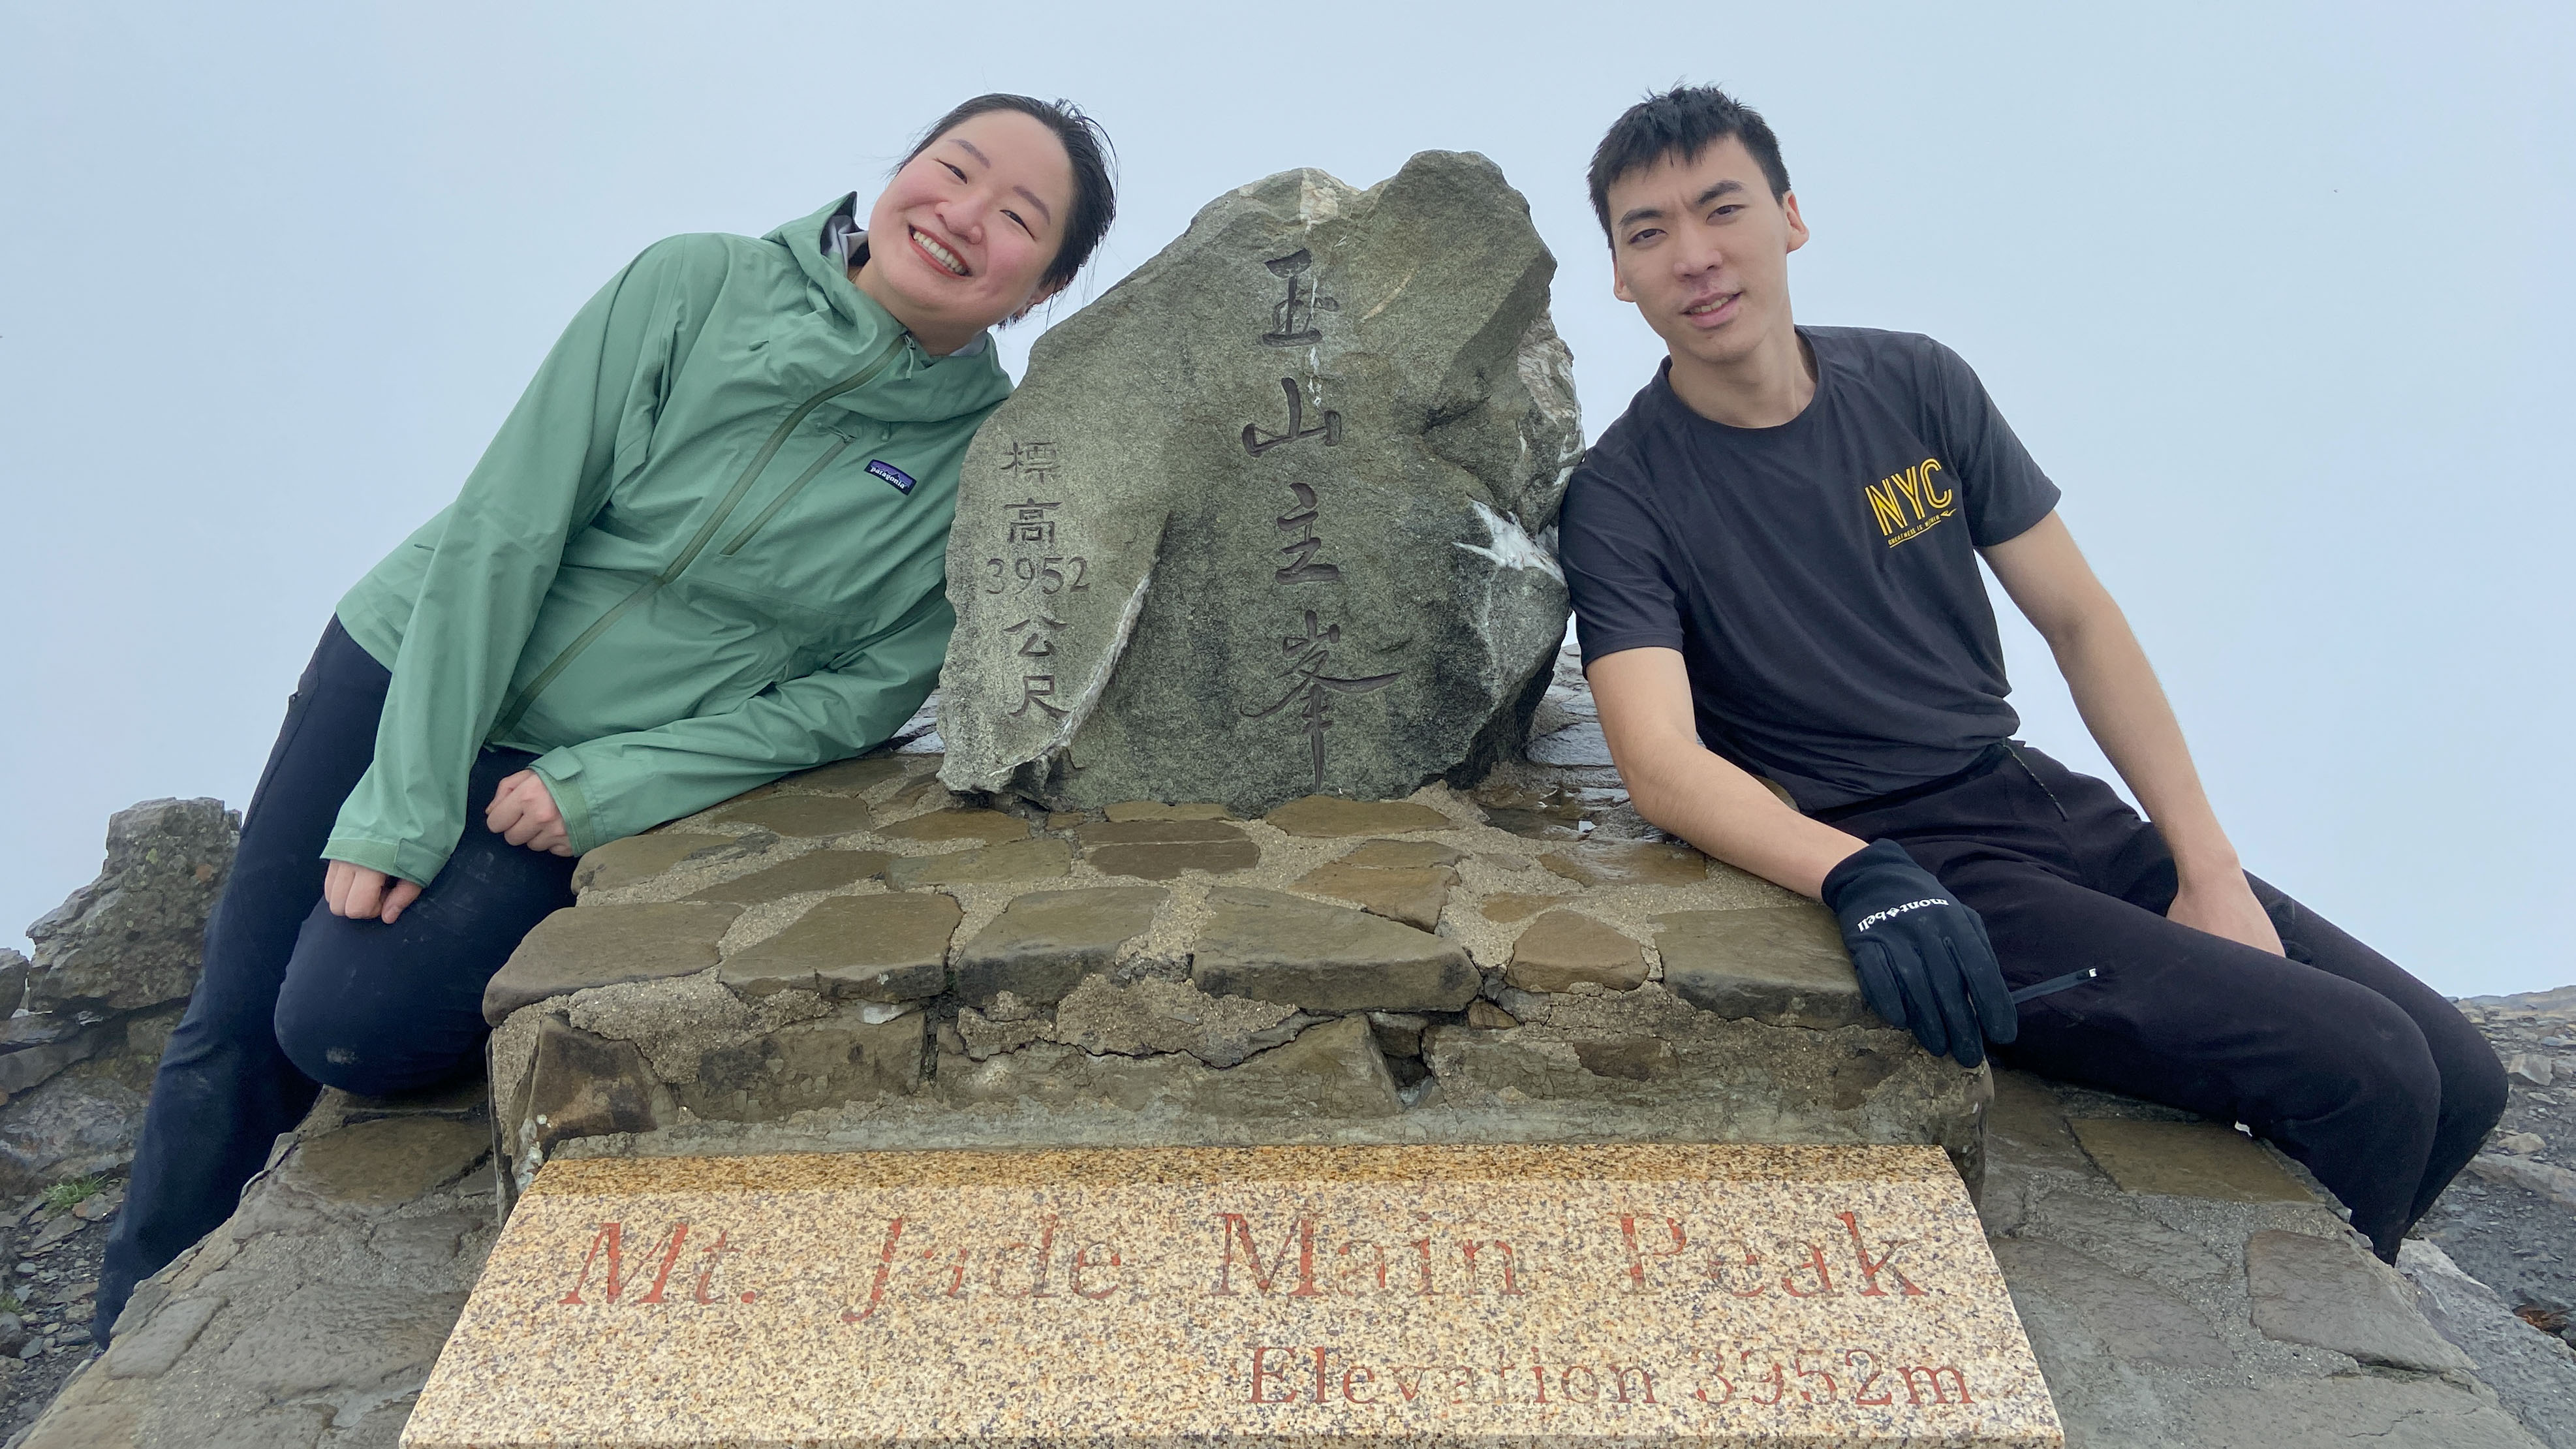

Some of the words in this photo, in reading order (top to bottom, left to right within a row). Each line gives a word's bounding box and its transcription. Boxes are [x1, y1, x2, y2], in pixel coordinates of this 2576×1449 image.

[870, 467, 905, 489] patagonia
[1865, 458, 1953, 536] NYC
[1887, 527, 1916, 546] GREATNESS
[557, 1222, 758, 1305] Mt.
[839, 1214, 1122, 1323] Jade
[1207, 1212, 1526, 1297] Main
[1619, 1211, 1928, 1298] Peak
[1246, 1345, 1658, 1405] Elevation
[1695, 1348, 1976, 1405] 3952m
